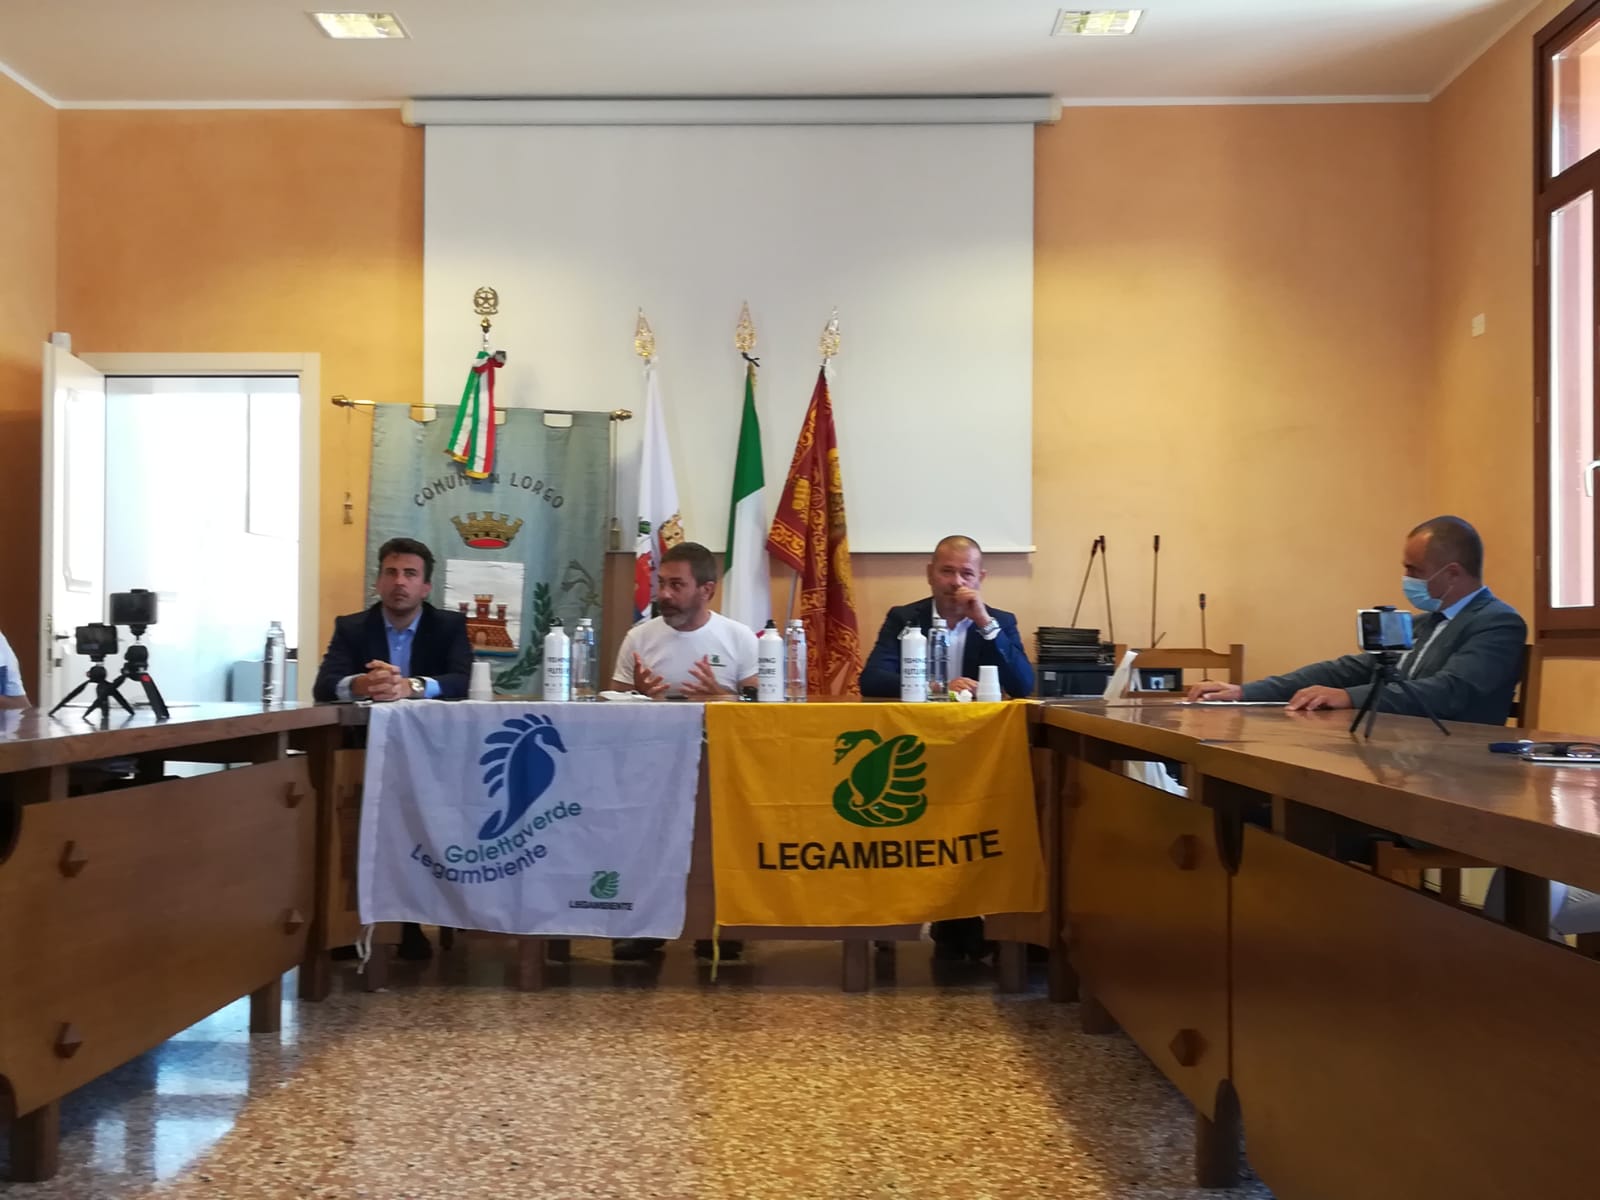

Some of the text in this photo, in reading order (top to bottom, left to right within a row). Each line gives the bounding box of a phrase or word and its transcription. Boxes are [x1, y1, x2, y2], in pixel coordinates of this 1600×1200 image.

[510, 472, 565, 509] LOREO
[444, 801, 582, 864] Golettaverde
[757, 829, 1003, 870] LEGAMBIENTE
[410, 843, 548, 884] Legambiente
